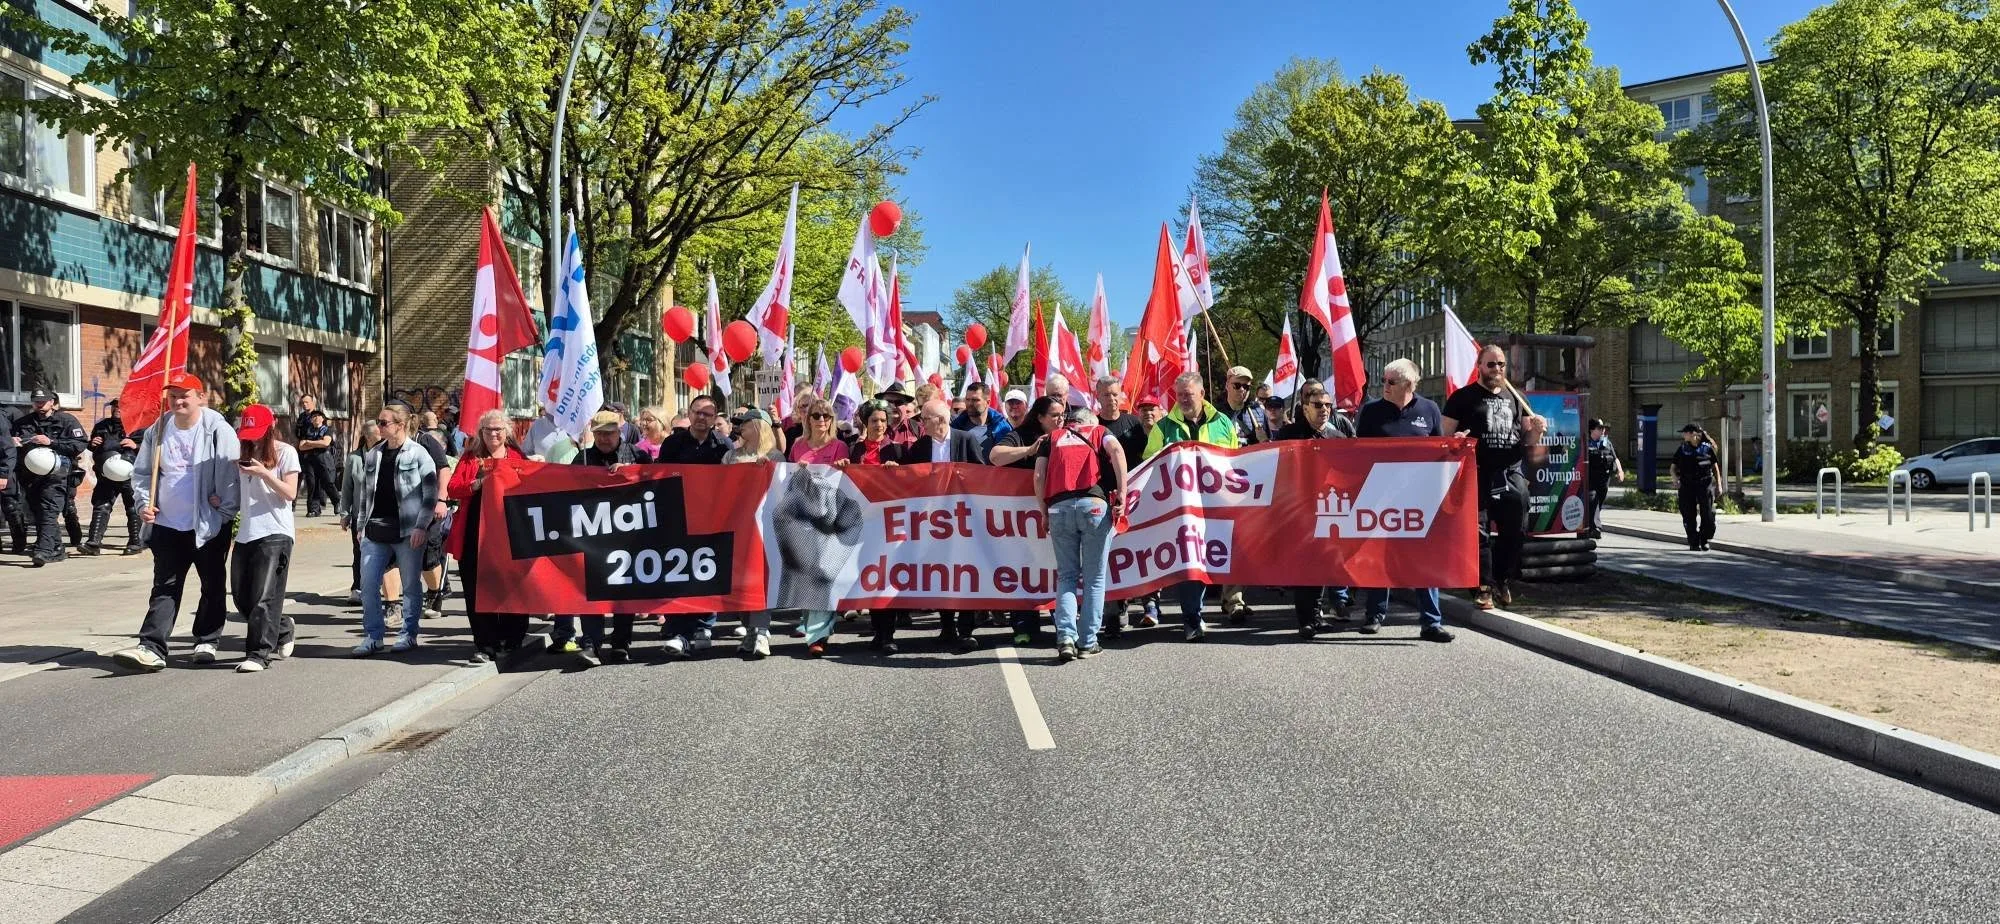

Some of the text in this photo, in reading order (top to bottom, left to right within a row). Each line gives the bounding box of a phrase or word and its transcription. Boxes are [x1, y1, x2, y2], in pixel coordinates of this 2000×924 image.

[1536, 432, 1576, 449] mburg
[1548, 450, 1569, 464] und
[1536, 467, 1581, 485] Olympia
[883, 501, 973, 544] Erst
[1152, 455, 1264, 502] Jobs,
[527, 490, 658, 542] 1. Mai
[1355, 508, 1425, 532] DGB
[606, 546, 717, 585] 2026
[860, 554, 980, 593] dann
[1108, 523, 1228, 584] Profite
